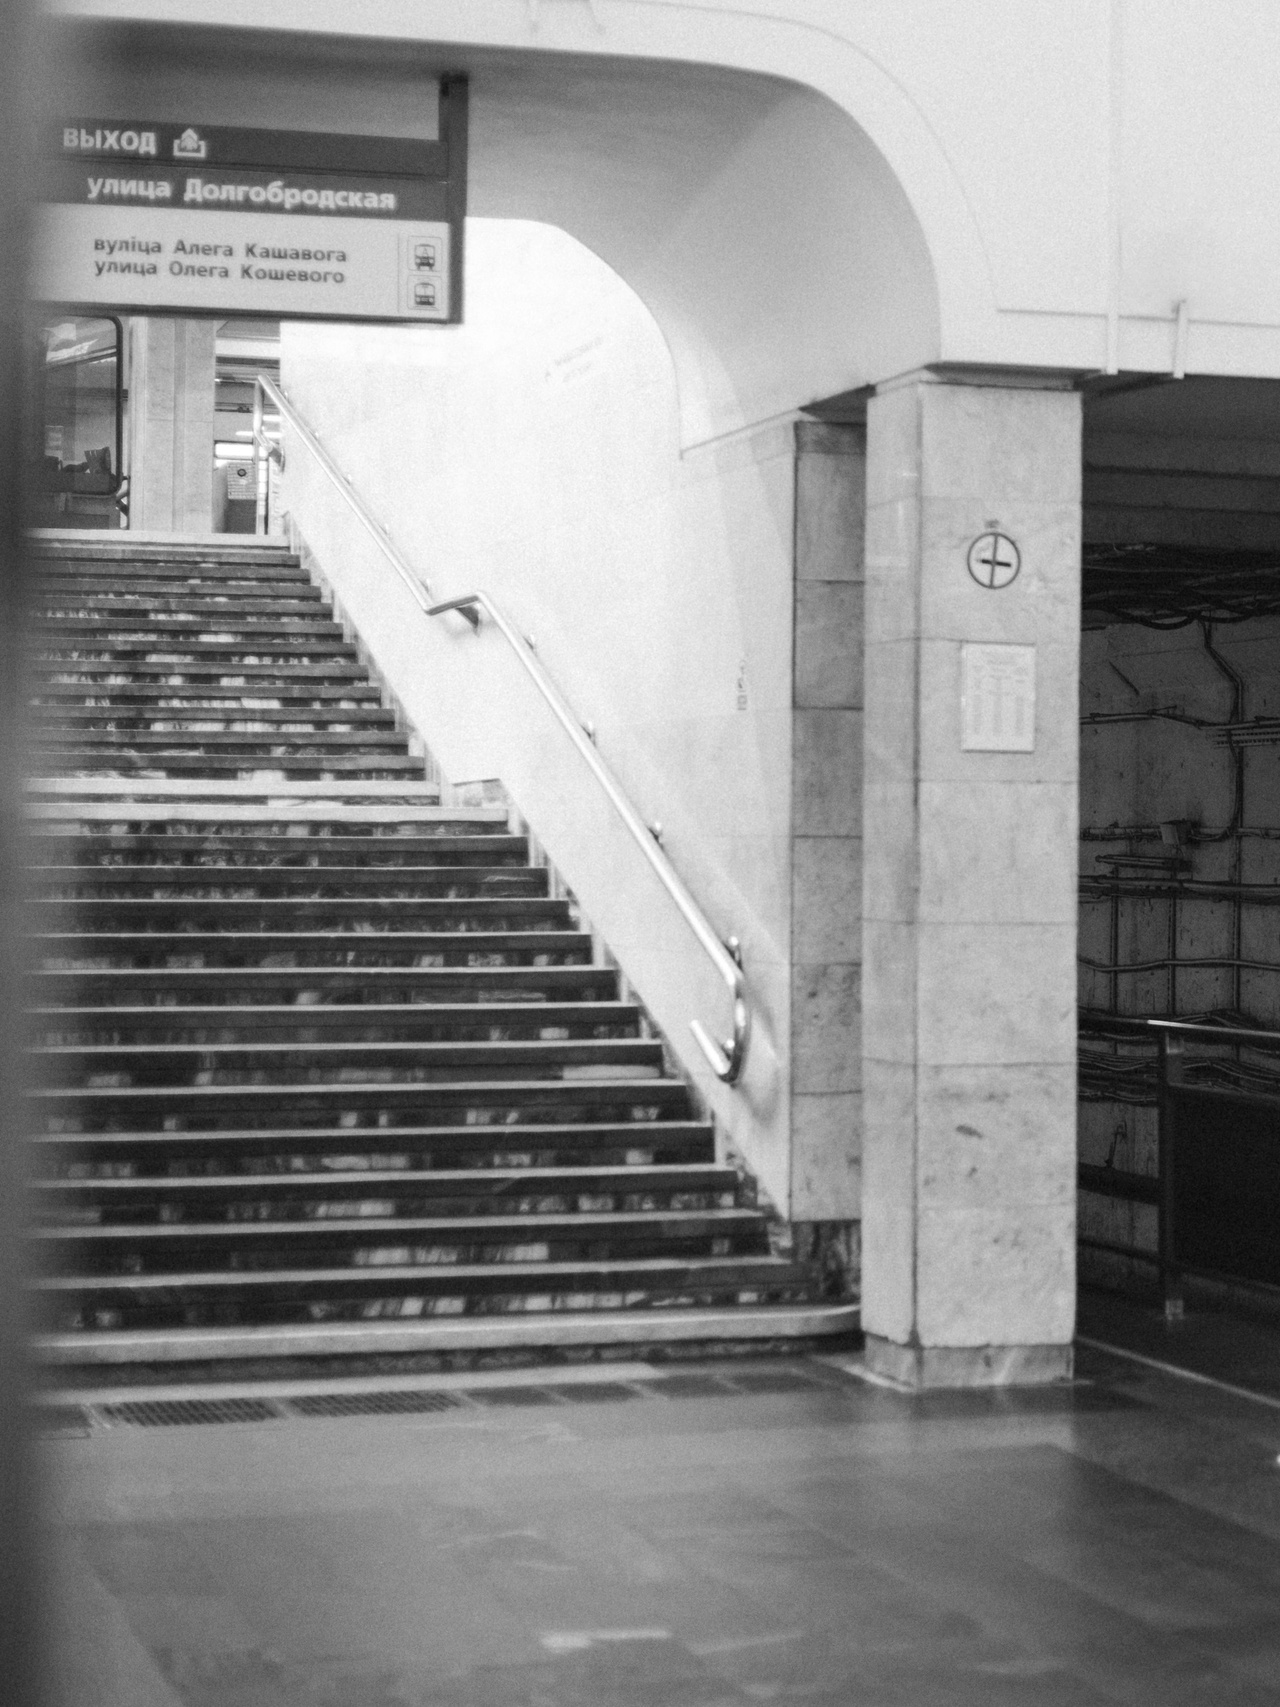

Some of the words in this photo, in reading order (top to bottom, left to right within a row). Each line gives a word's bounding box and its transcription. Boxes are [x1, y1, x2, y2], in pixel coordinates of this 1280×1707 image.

[62, 127, 157, 155] ВЫХОД
[87, 177, 173, 200] улица
[183, 177, 397, 211] Долгобродская
[94, 236, 162, 255] вуліца
[173, 239, 234, 257] Алега
[244, 243, 347, 263] Кашавога
[94, 260, 158, 278] улица
[168, 260, 230, 279] Олега
[240, 264, 345, 284] Кошевого
